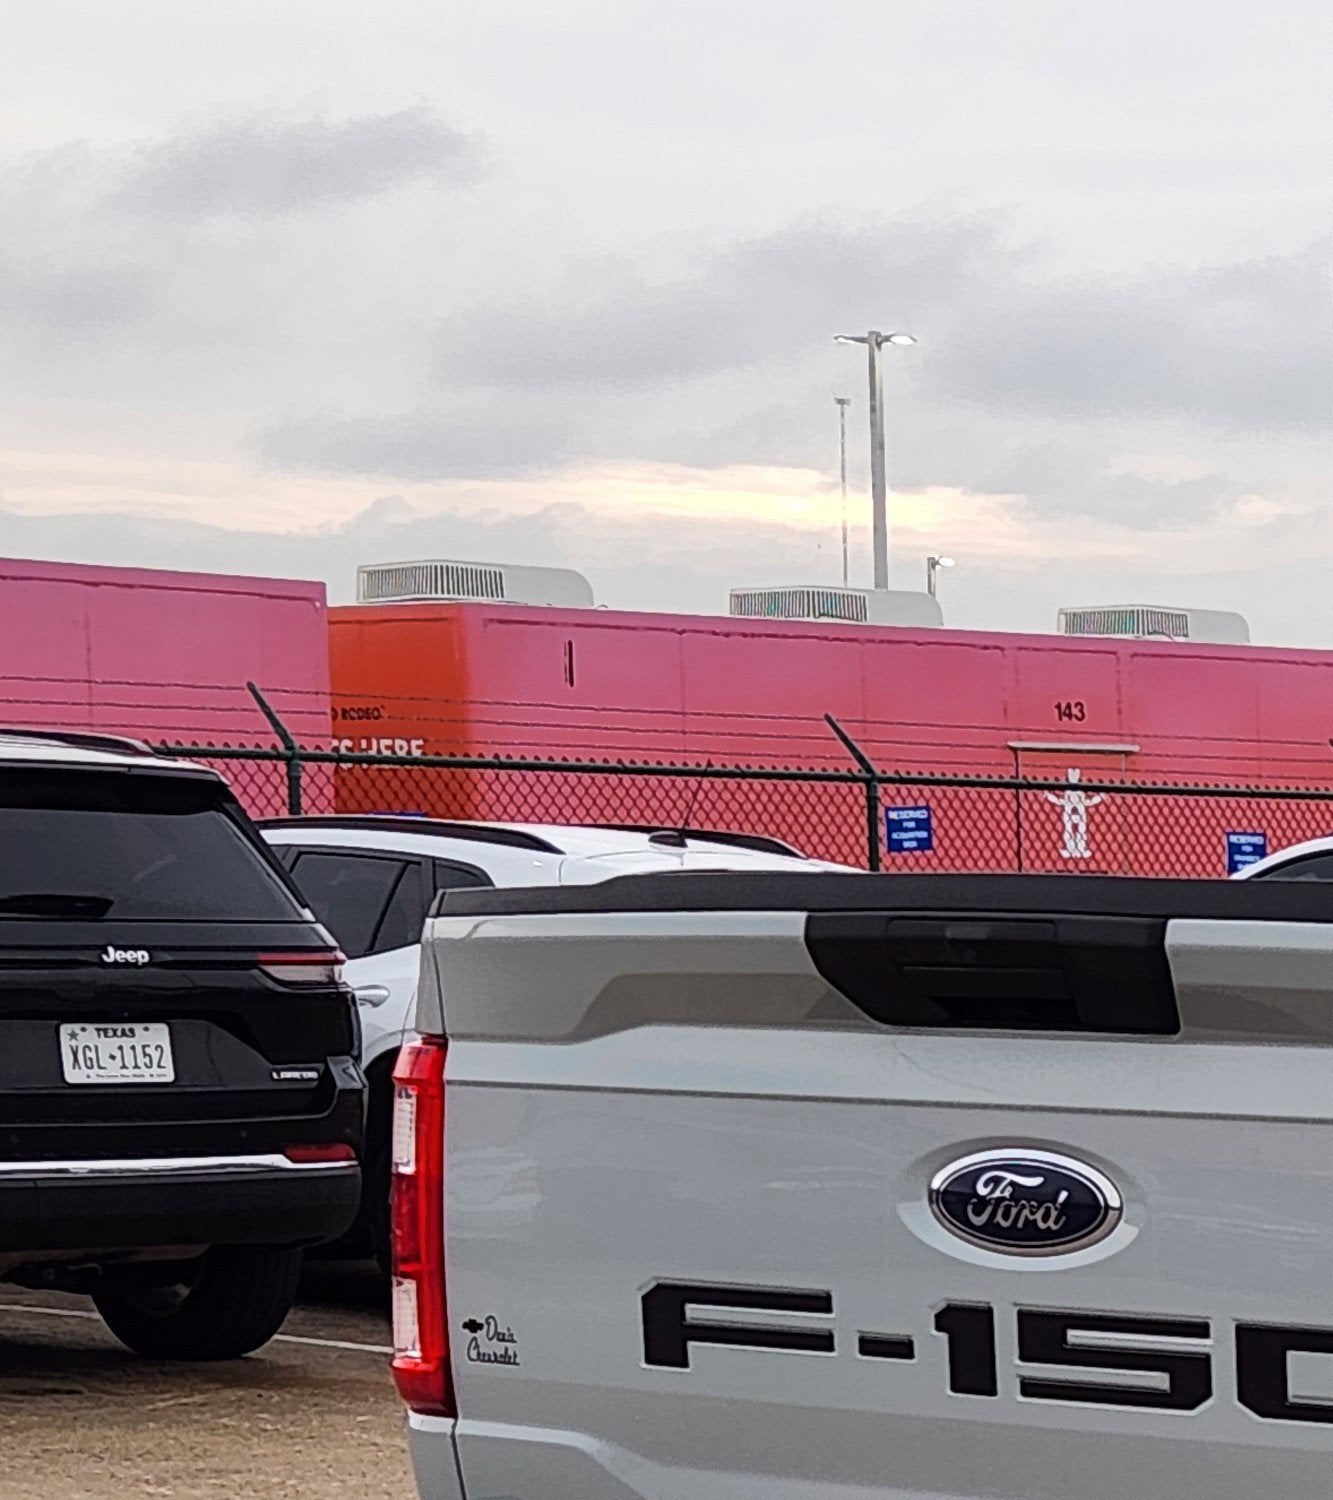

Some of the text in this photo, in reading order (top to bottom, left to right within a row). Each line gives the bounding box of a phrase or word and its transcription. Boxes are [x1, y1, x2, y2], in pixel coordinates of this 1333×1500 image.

[1054, 701, 1086, 722] 143
[101, 945, 150, 966] Jeep
[94, 1027, 136, 1039] TEXAS
[966, 1170, 1069, 1230] Ford
